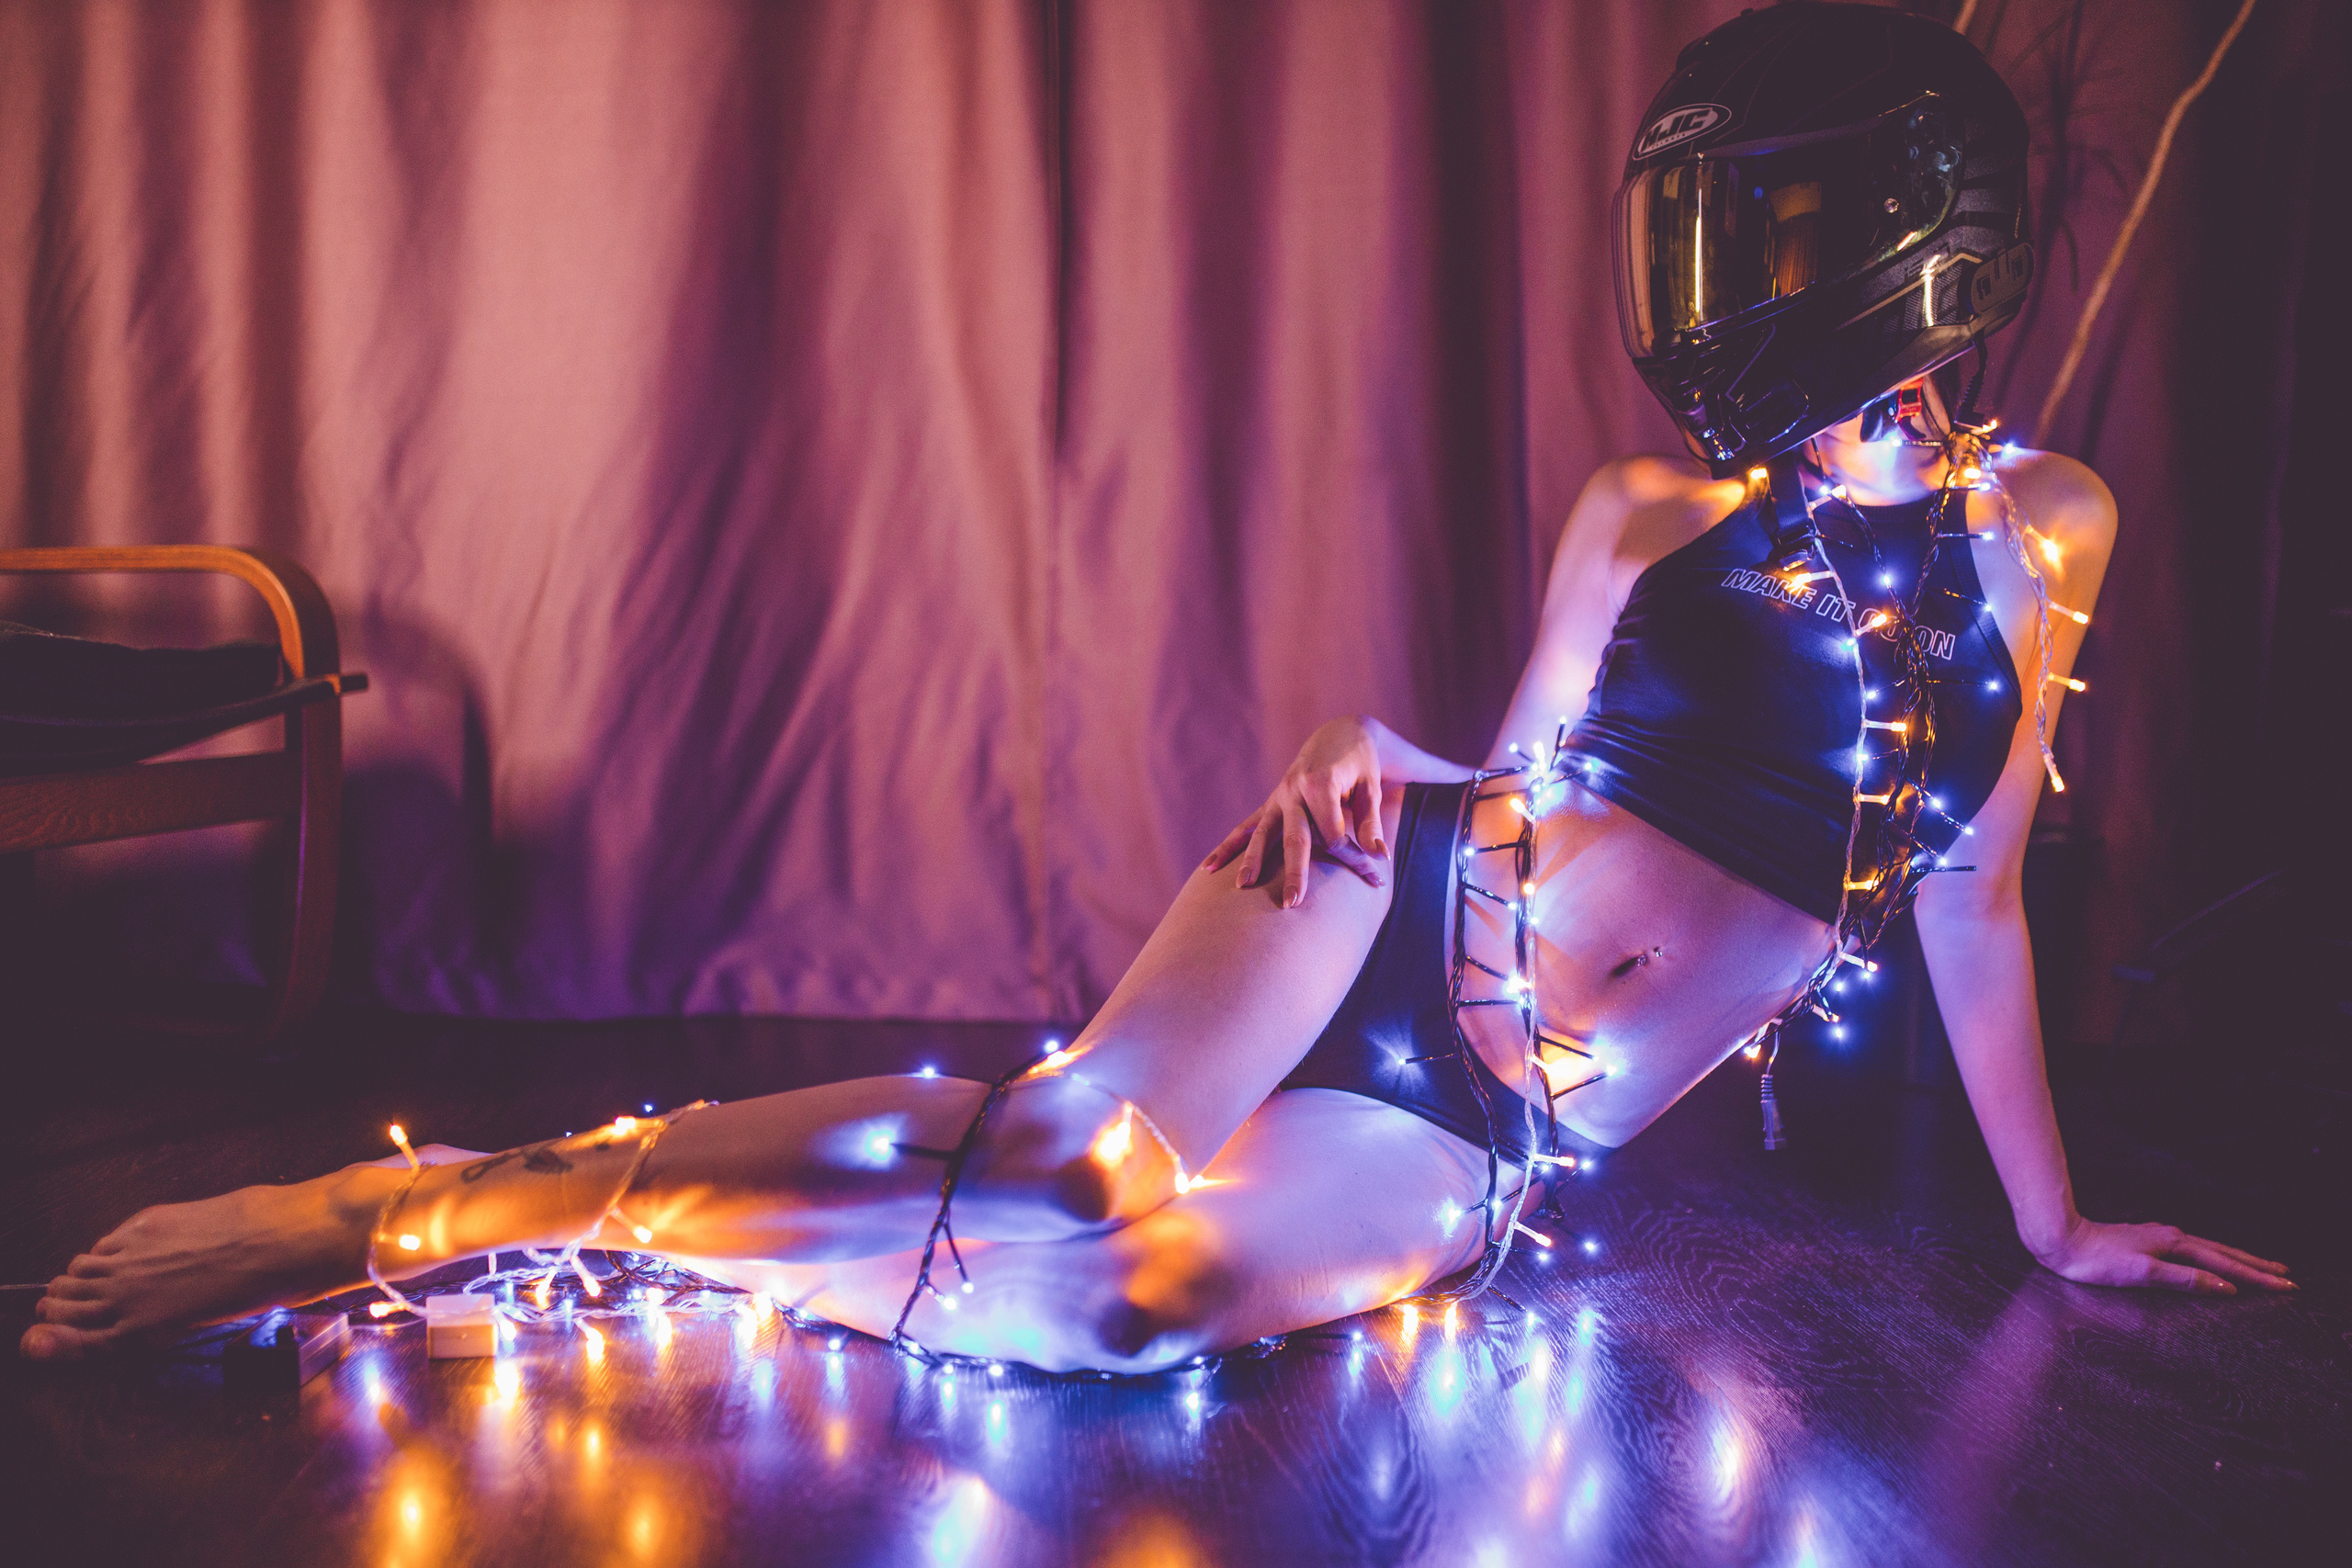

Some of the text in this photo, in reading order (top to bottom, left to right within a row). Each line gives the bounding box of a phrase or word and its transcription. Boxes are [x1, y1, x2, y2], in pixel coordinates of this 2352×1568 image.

[1640, 107, 1713, 154] HJC
[1721, 568, 1817, 610] MAKE
[1815, 593, 1856, 623] IT
[1914, 625, 1956, 661] ON
